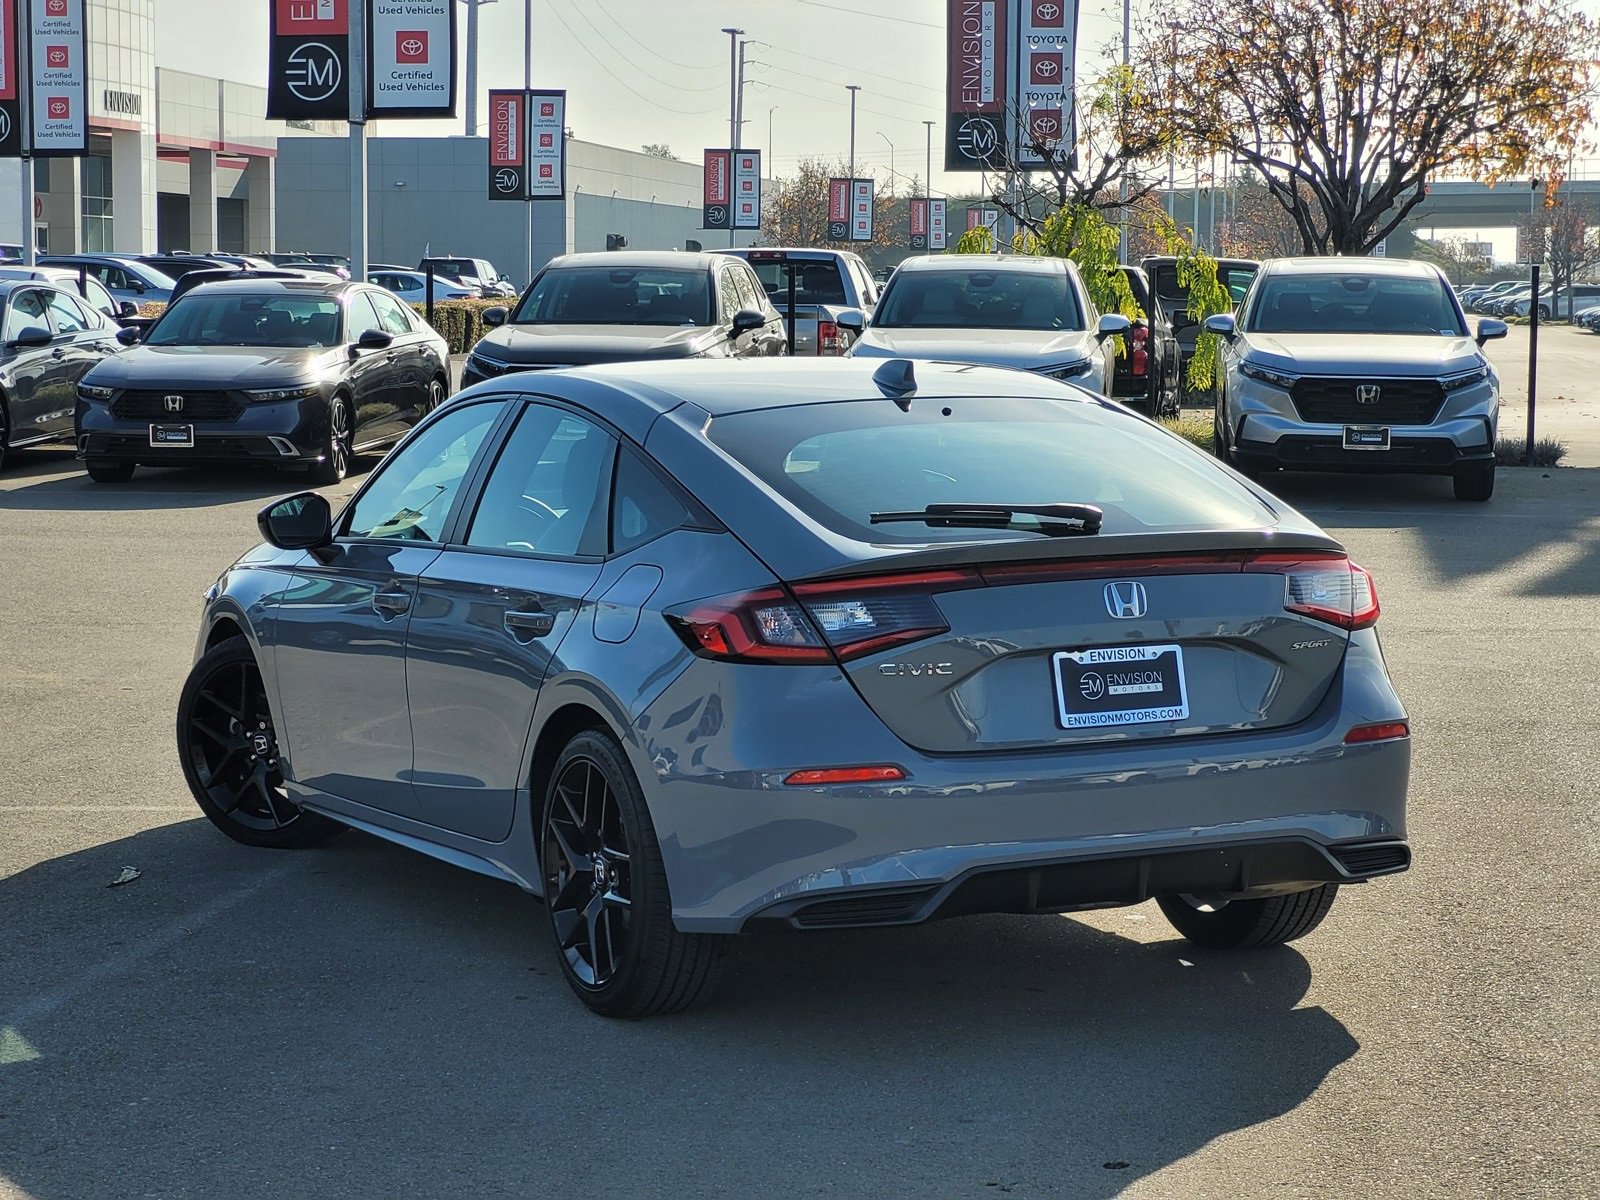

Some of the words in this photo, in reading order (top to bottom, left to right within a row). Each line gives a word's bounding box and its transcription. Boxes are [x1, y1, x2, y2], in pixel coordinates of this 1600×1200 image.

[378, 6, 403, 14] Used
[405, 6, 445, 14] Vehicles
[1026, 35, 1068, 43] TOYOTA
[962, 1, 980, 103] ENVISION
[984, 11, 992, 94] MOTORS
[391, 71, 432, 79] Certified
[379, 83, 403, 91] Used
[405, 83, 445, 91] Vehicles
[1025, 93, 1067, 101] TOYOTA
[497, 100, 508, 160] ENVISION
[1025, 149, 1067, 157] TOTA
[710, 156, 718, 200] ENVISION
[1291, 639, 1331, 650] SPORT
[1090, 649, 1146, 661] ENVISION
[879, 663, 952, 675] CIVIC
[1107, 671, 1162, 686] ENVISION
[1113, 685, 1159, 693] MOTORS
[1068, 708, 1183, 726] ENVISIONMOTORS.COM
